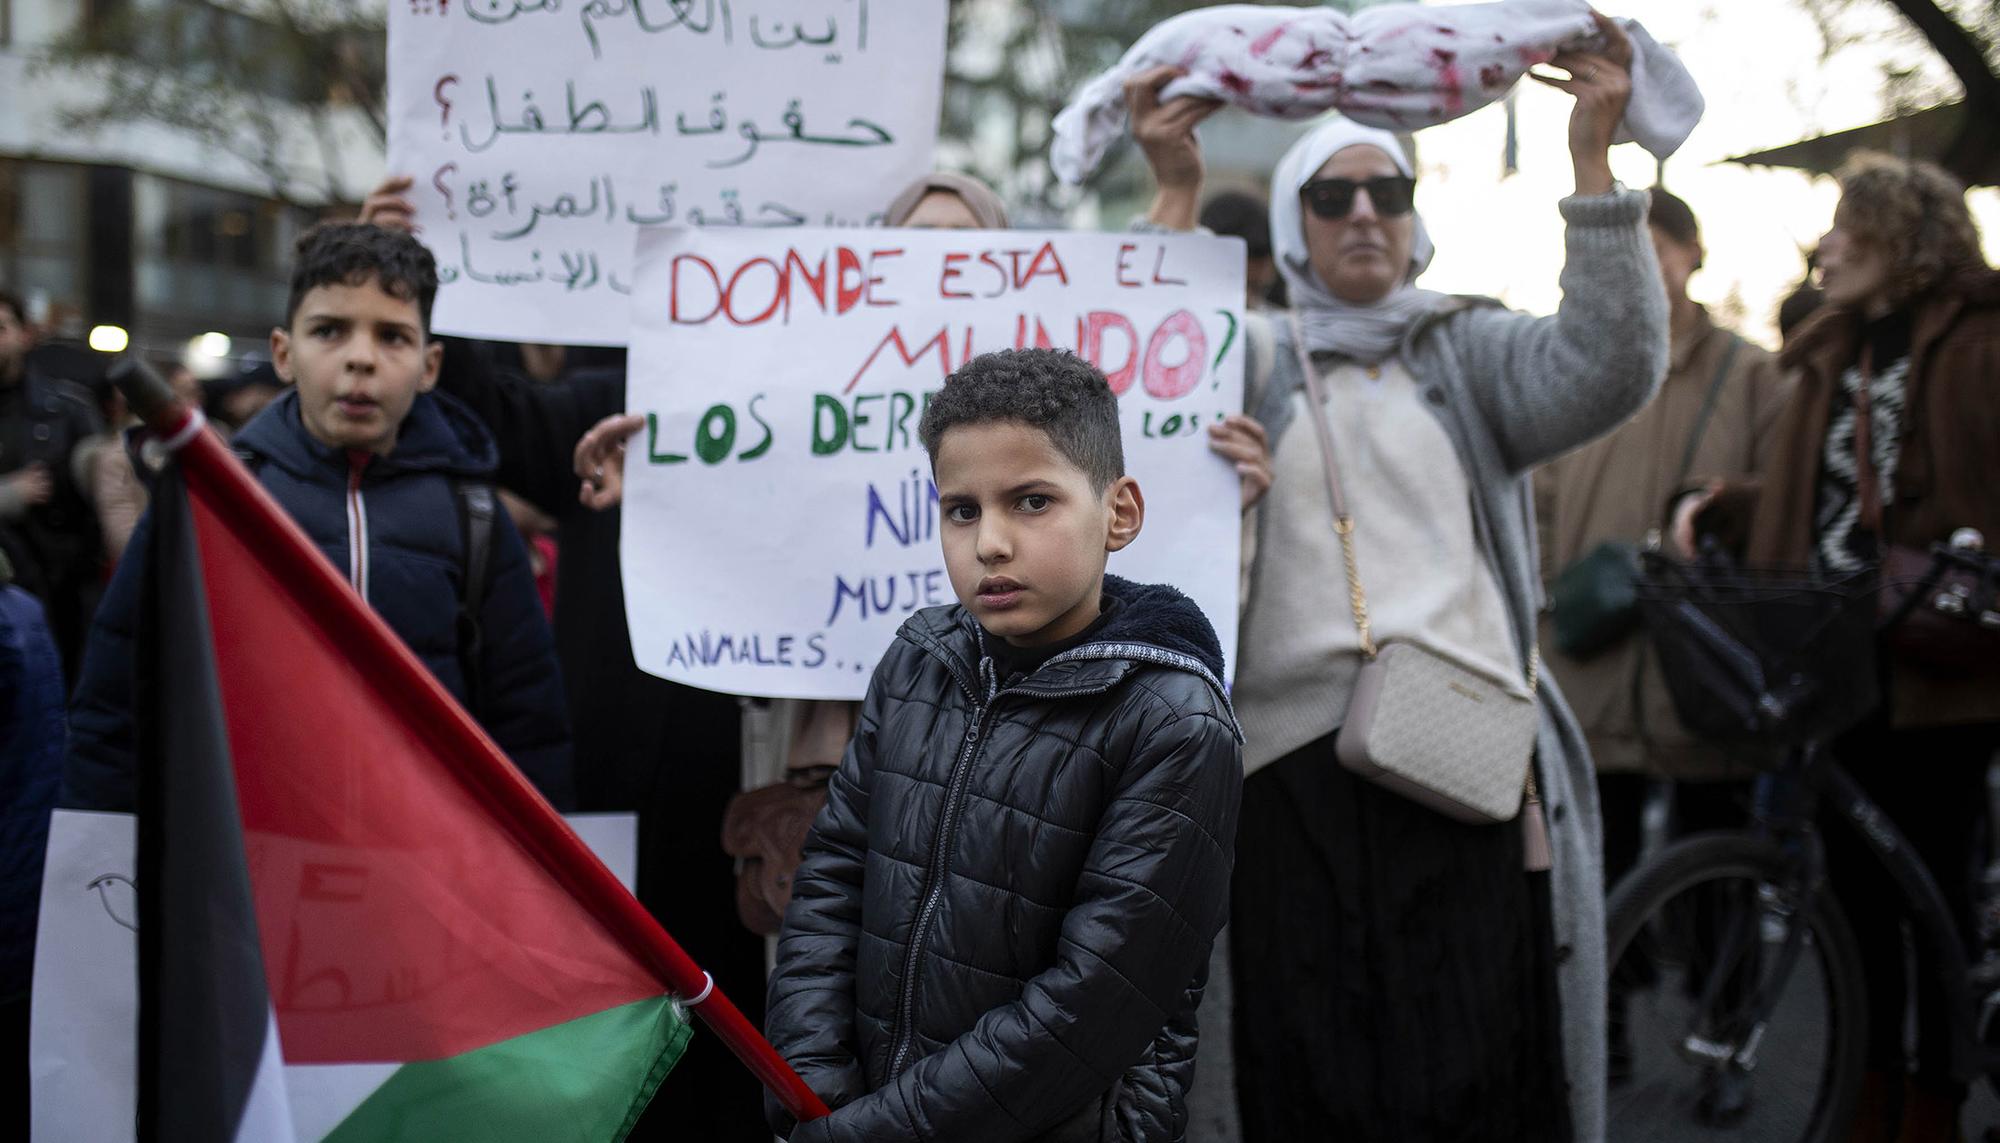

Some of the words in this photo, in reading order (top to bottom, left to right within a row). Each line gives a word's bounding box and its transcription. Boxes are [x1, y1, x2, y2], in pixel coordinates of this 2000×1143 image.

[670, 246, 905, 325] DONDE
[939, 240, 1069, 299] ESTA
[1116, 244, 1188, 287] EL
[647, 393, 772, 465] LOS
